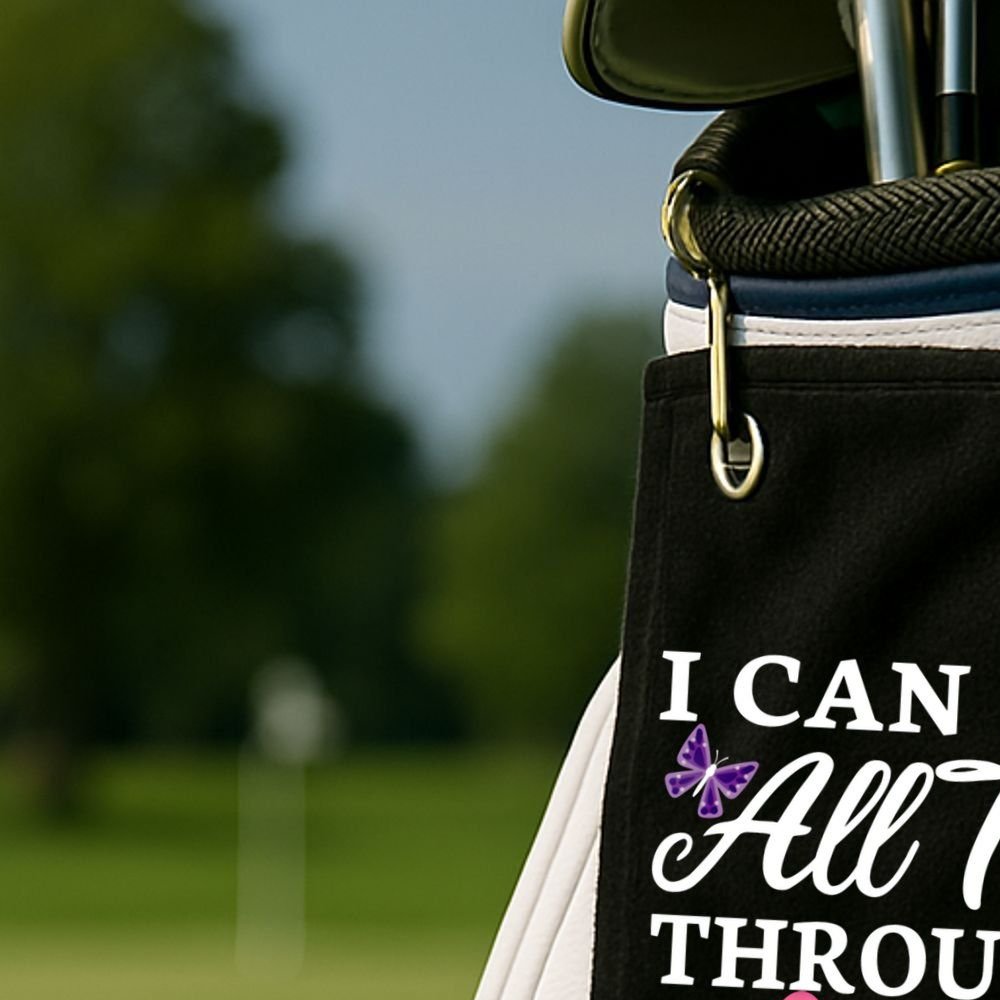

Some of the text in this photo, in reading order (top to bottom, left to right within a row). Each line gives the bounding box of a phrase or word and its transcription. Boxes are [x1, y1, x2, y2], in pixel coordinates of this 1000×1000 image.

[659, 650, 702, 722] I
[733, 653, 972, 736] CAN
[651, 751, 935, 898] All
